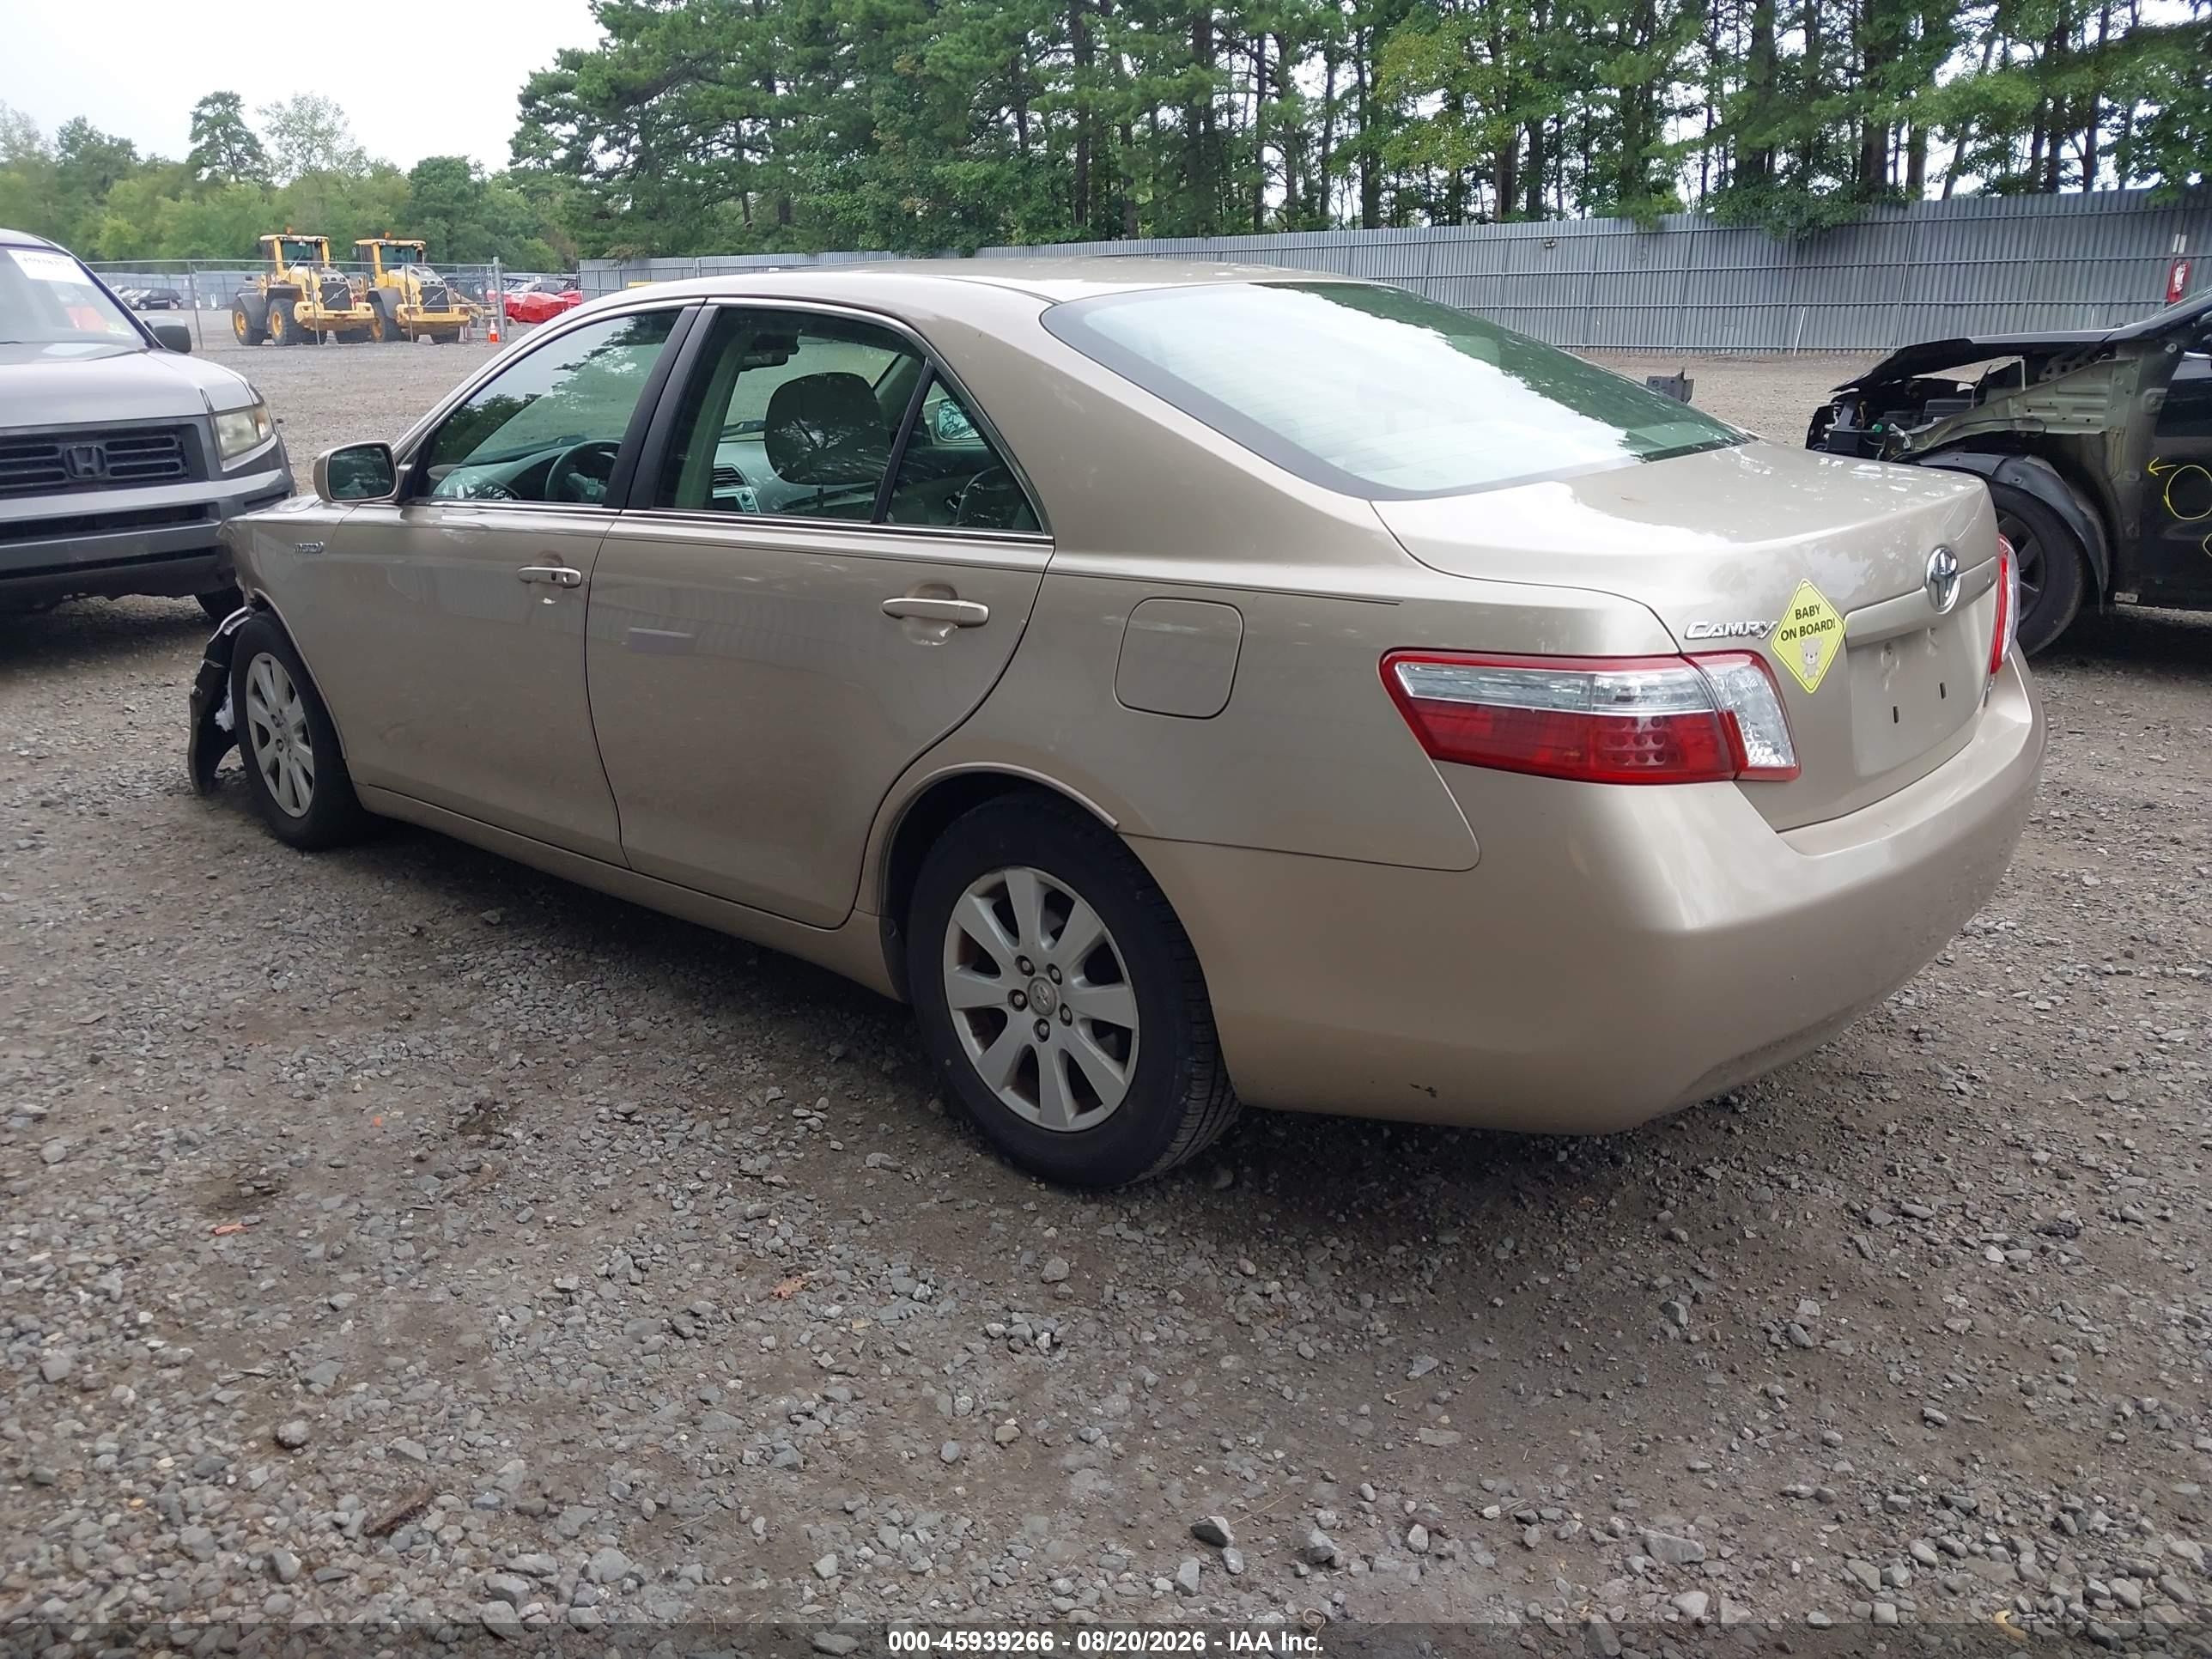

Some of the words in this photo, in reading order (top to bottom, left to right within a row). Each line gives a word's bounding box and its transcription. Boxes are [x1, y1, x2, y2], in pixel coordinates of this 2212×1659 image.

[1795, 603, 1821, 621] BABY
[1685, 620, 1778, 640] CAMRY
[1780, 627, 1797, 642] ON
[1799, 617, 1836, 638] BOARD!
